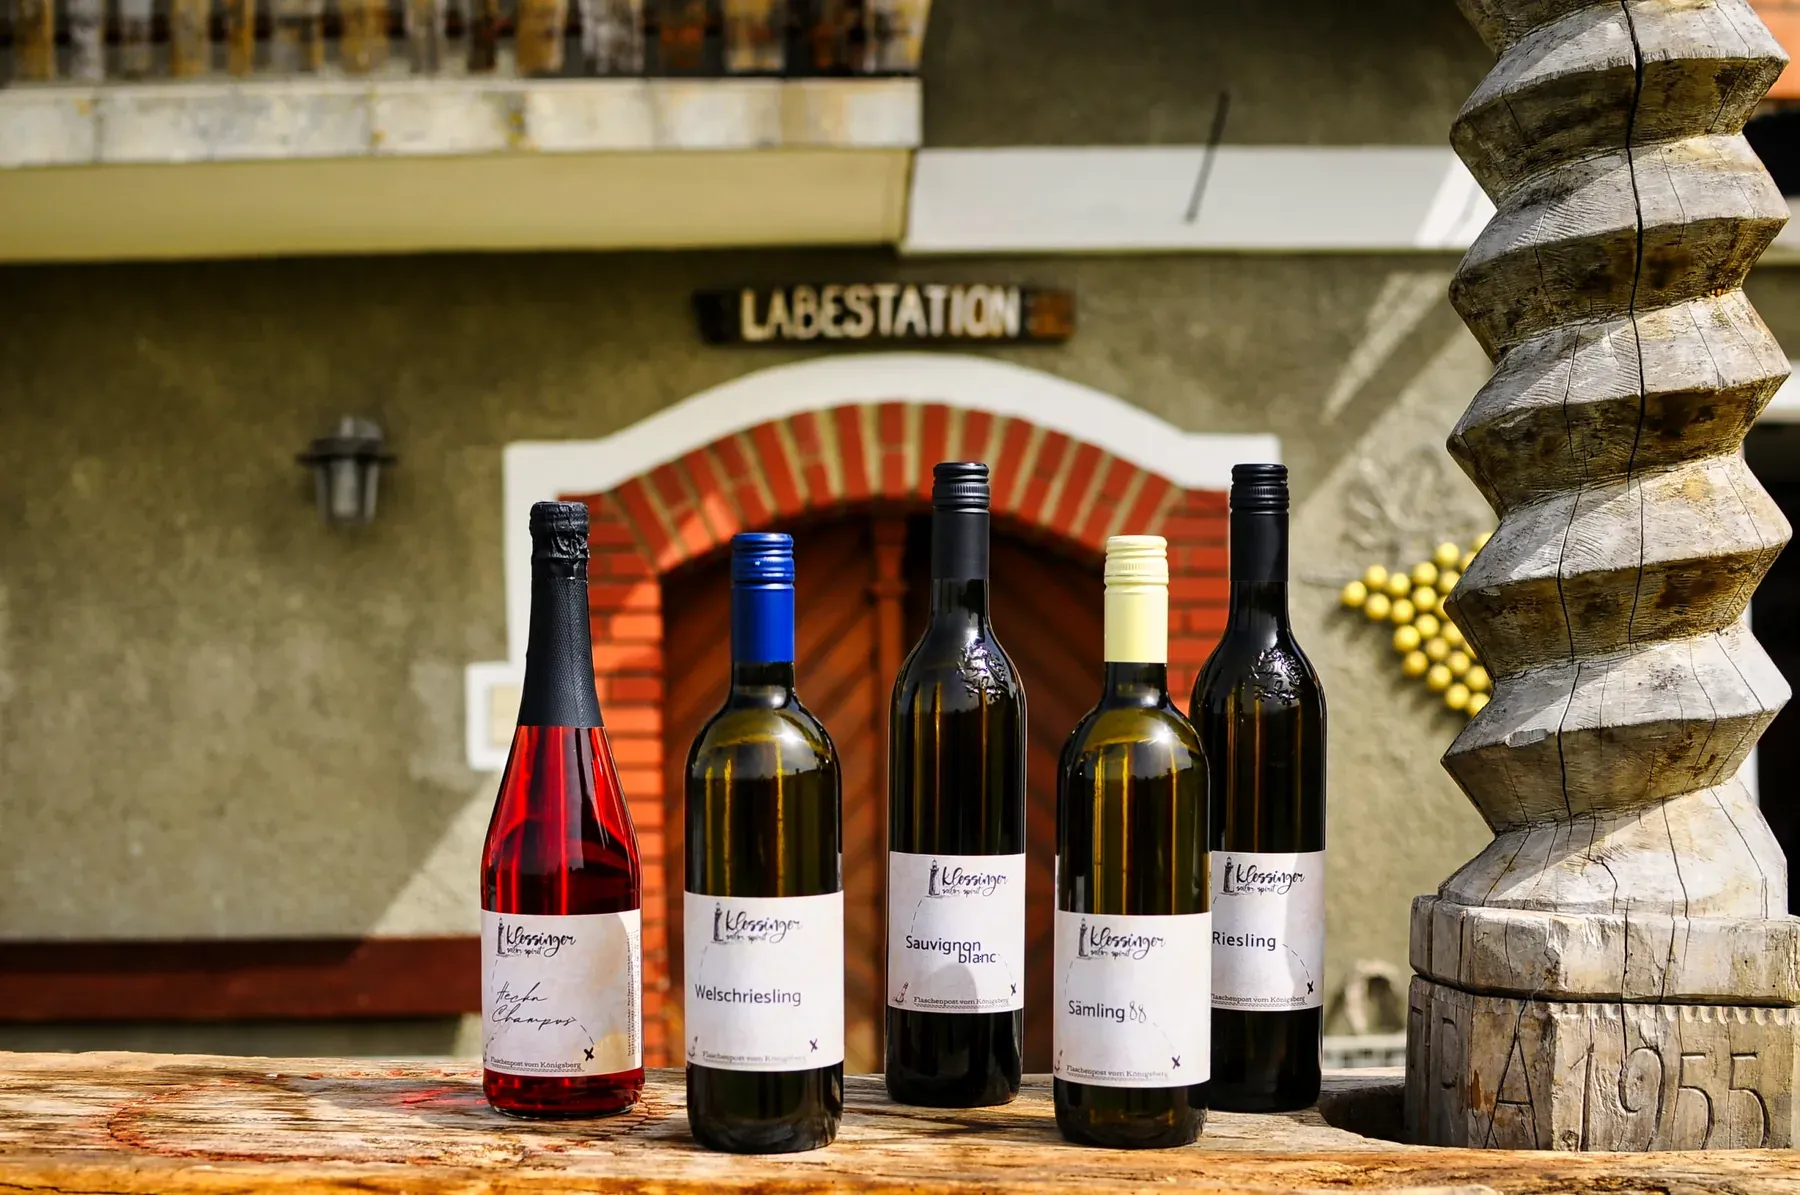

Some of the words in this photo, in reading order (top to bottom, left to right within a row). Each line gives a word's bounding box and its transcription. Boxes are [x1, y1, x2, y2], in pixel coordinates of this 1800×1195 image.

[739, 284, 1020, 341] LABESTATION
[906, 935, 982, 955] Sauvignon
[1211, 931, 1277, 951] Riesling
[958, 949, 997, 964] blanc
[694, 984, 802, 1006] Welschriesling
[1068, 1000, 1125, 1023] Sämling
[1129, 1001, 1147, 1023] 88
